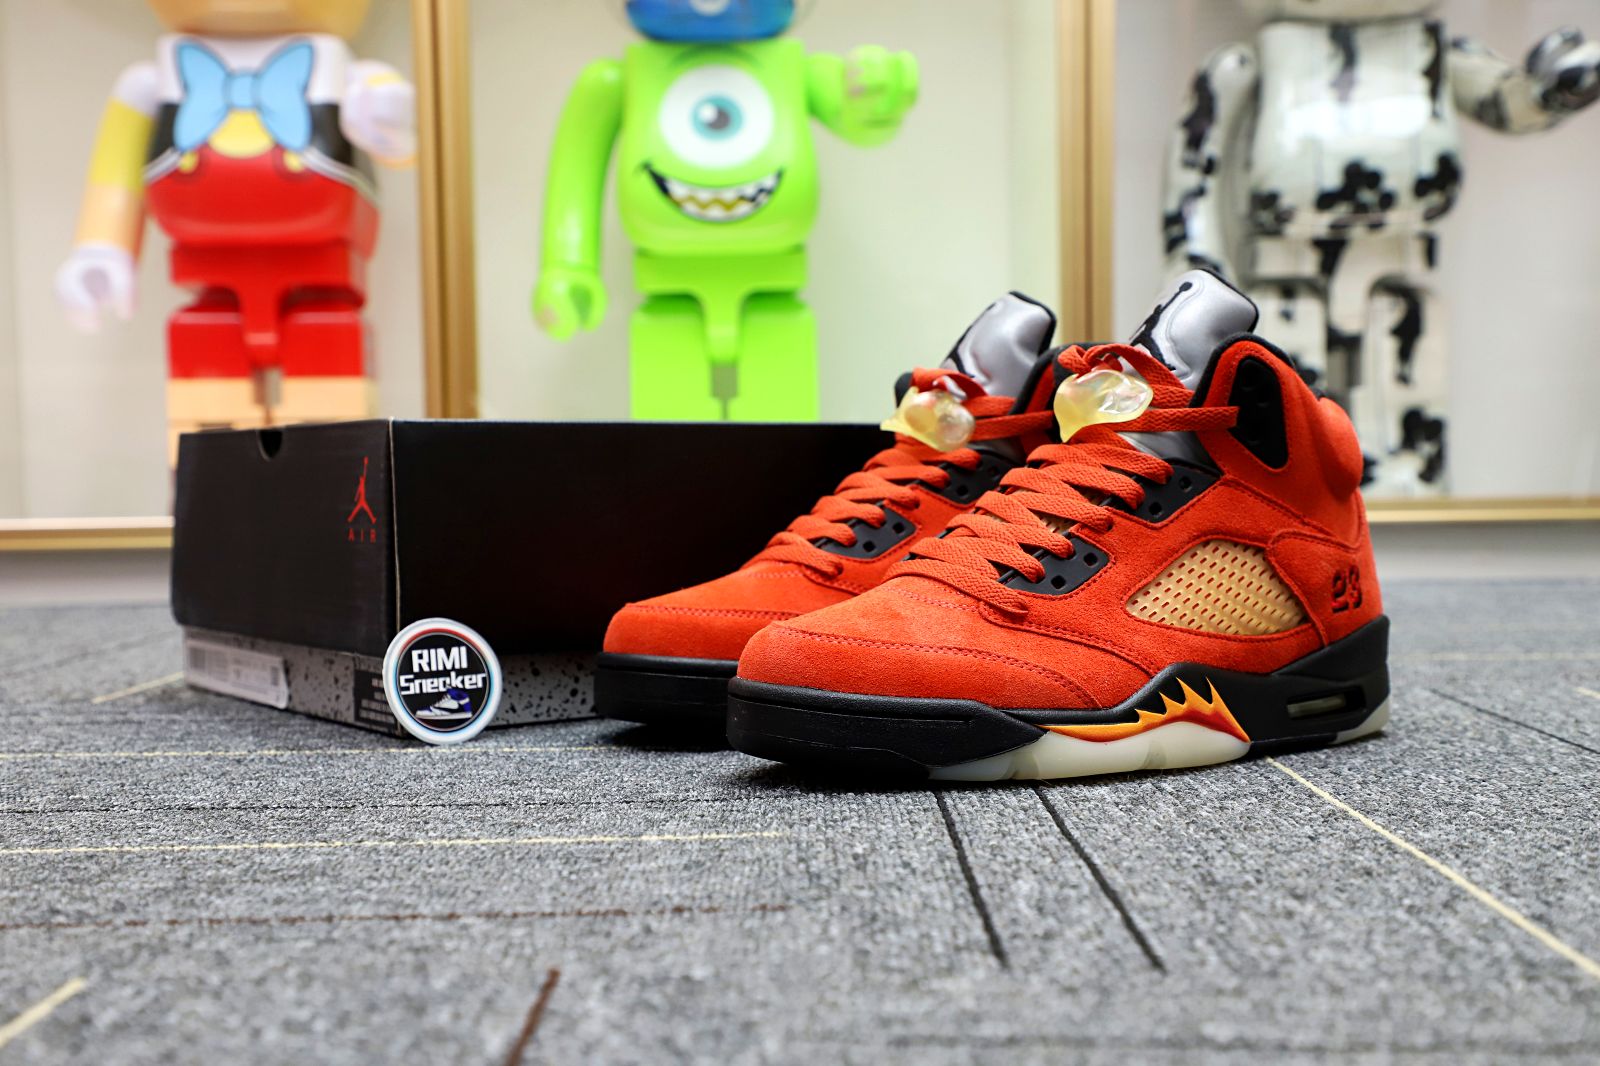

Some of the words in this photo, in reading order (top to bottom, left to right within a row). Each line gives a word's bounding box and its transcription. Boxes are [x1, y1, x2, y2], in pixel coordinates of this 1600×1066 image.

[348, 528, 377, 542] AIR
[1331, 565, 1363, 613] 23
[411, 646, 468, 673] RIMI
[399, 671, 487, 696] Sneaker
